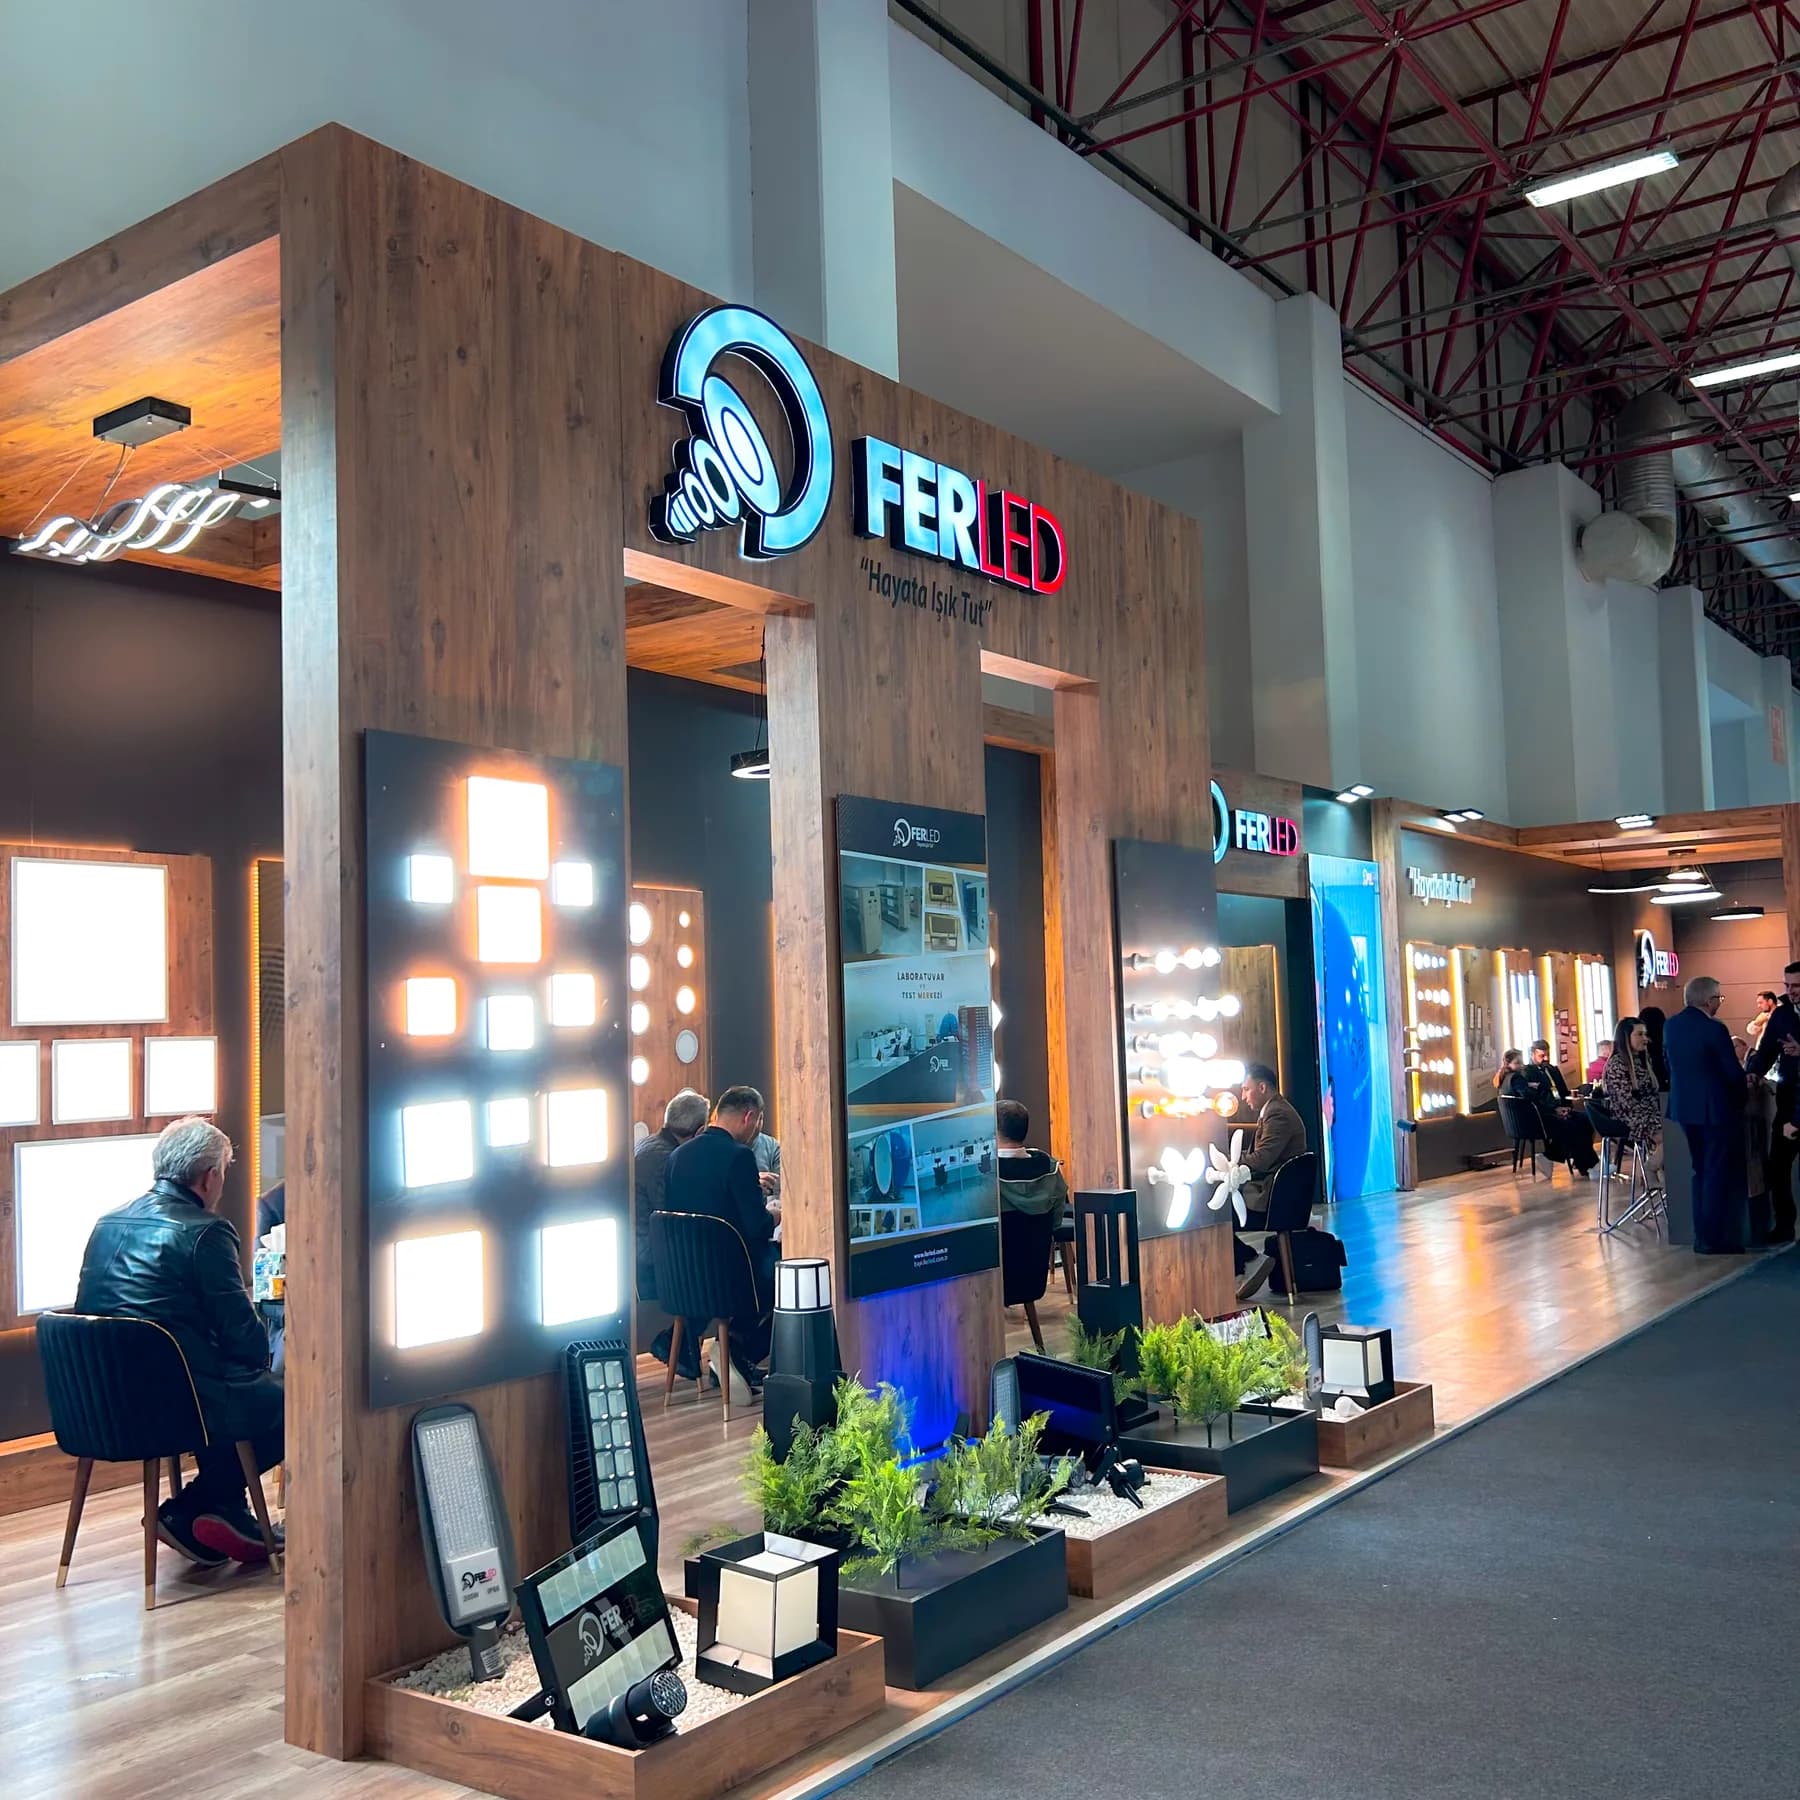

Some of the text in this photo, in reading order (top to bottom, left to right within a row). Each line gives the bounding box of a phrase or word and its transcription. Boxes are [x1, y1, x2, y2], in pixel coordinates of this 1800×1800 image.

[858, 435, 1068, 595] FERLED
[932, 581, 957, 622] Işık
[911, 826, 941, 843] FERLED
[1233, 809, 1299, 856] FERLED
[896, 971, 945, 981] LABORATUVAR
[902, 991, 916, 999] TEST
